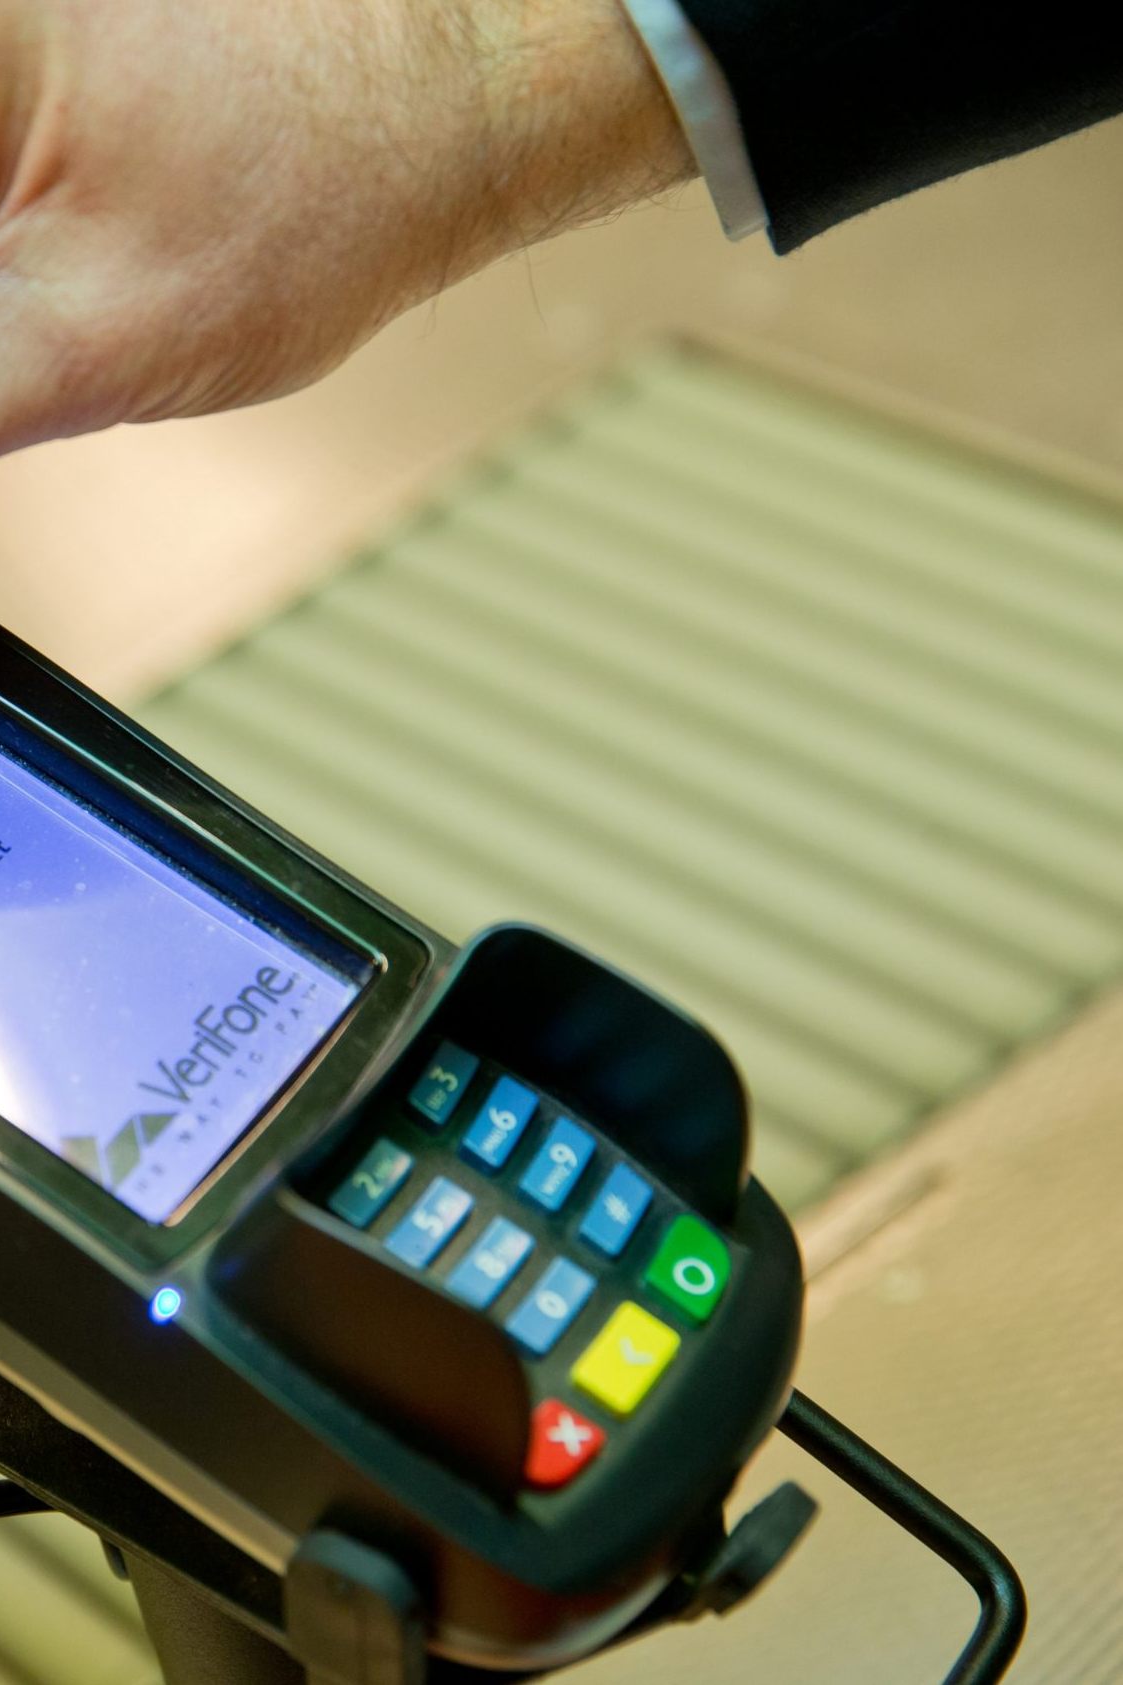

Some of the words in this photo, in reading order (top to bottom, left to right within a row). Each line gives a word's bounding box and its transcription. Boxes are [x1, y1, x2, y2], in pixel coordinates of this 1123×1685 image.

[138, 966, 294, 1103] VeriFone
[429, 1065, 458, 1092] 3
[489, 1106, 517, 1131] 6
[549, 1143, 578, 1168] 9
[352, 1171, 384, 1199] 2
[412, 1209, 445, 1239] 5
[475, 1251, 507, 1279] 8
